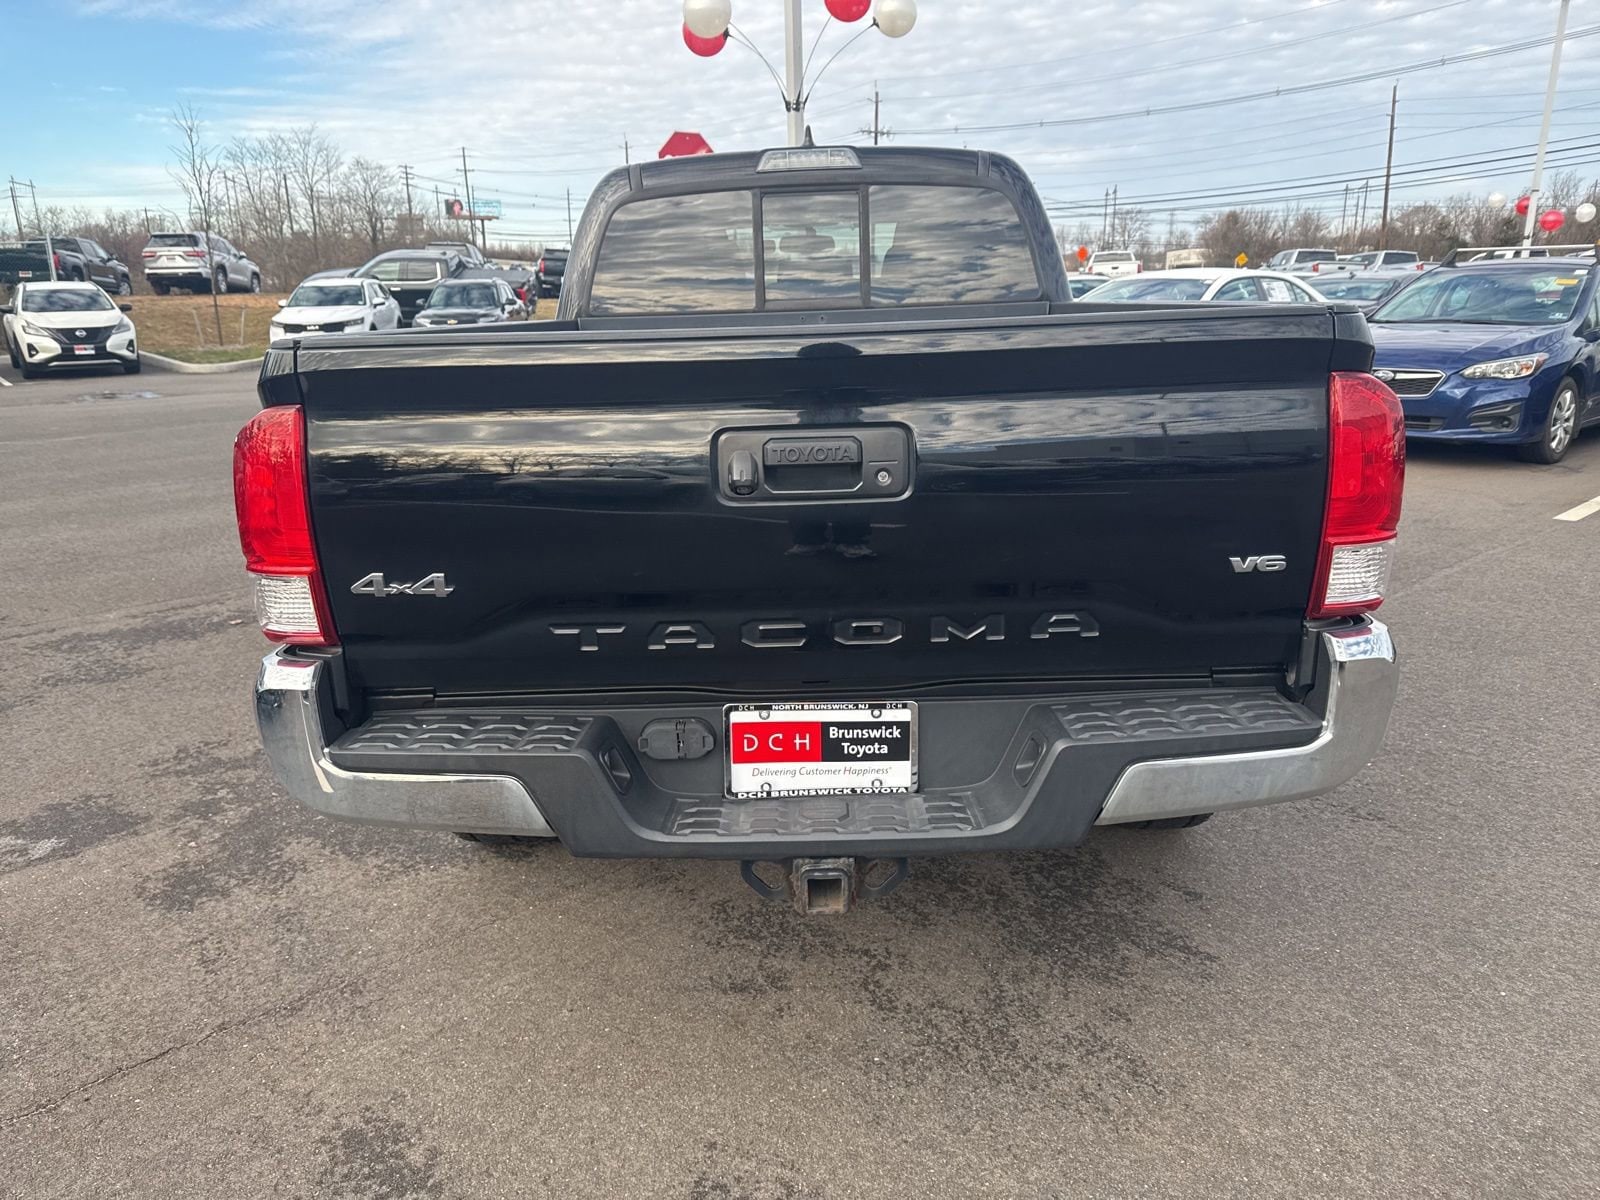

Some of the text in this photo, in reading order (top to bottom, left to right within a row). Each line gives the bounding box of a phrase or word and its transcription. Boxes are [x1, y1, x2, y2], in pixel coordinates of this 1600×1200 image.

[772, 446, 854, 463] TOYOTA
[1229, 555, 1287, 573] V6
[351, 572, 454, 598] 4x4
[550, 611, 1101, 652] TACOMA
[829, 725, 902, 739] Brunswick
[841, 742, 889, 758] Toyota
[752, 767, 797, 777] Delivering
[798, 766, 841, 776] Customer
[738, 786, 908, 799] DCH BRUNSWICK TOYOTA
